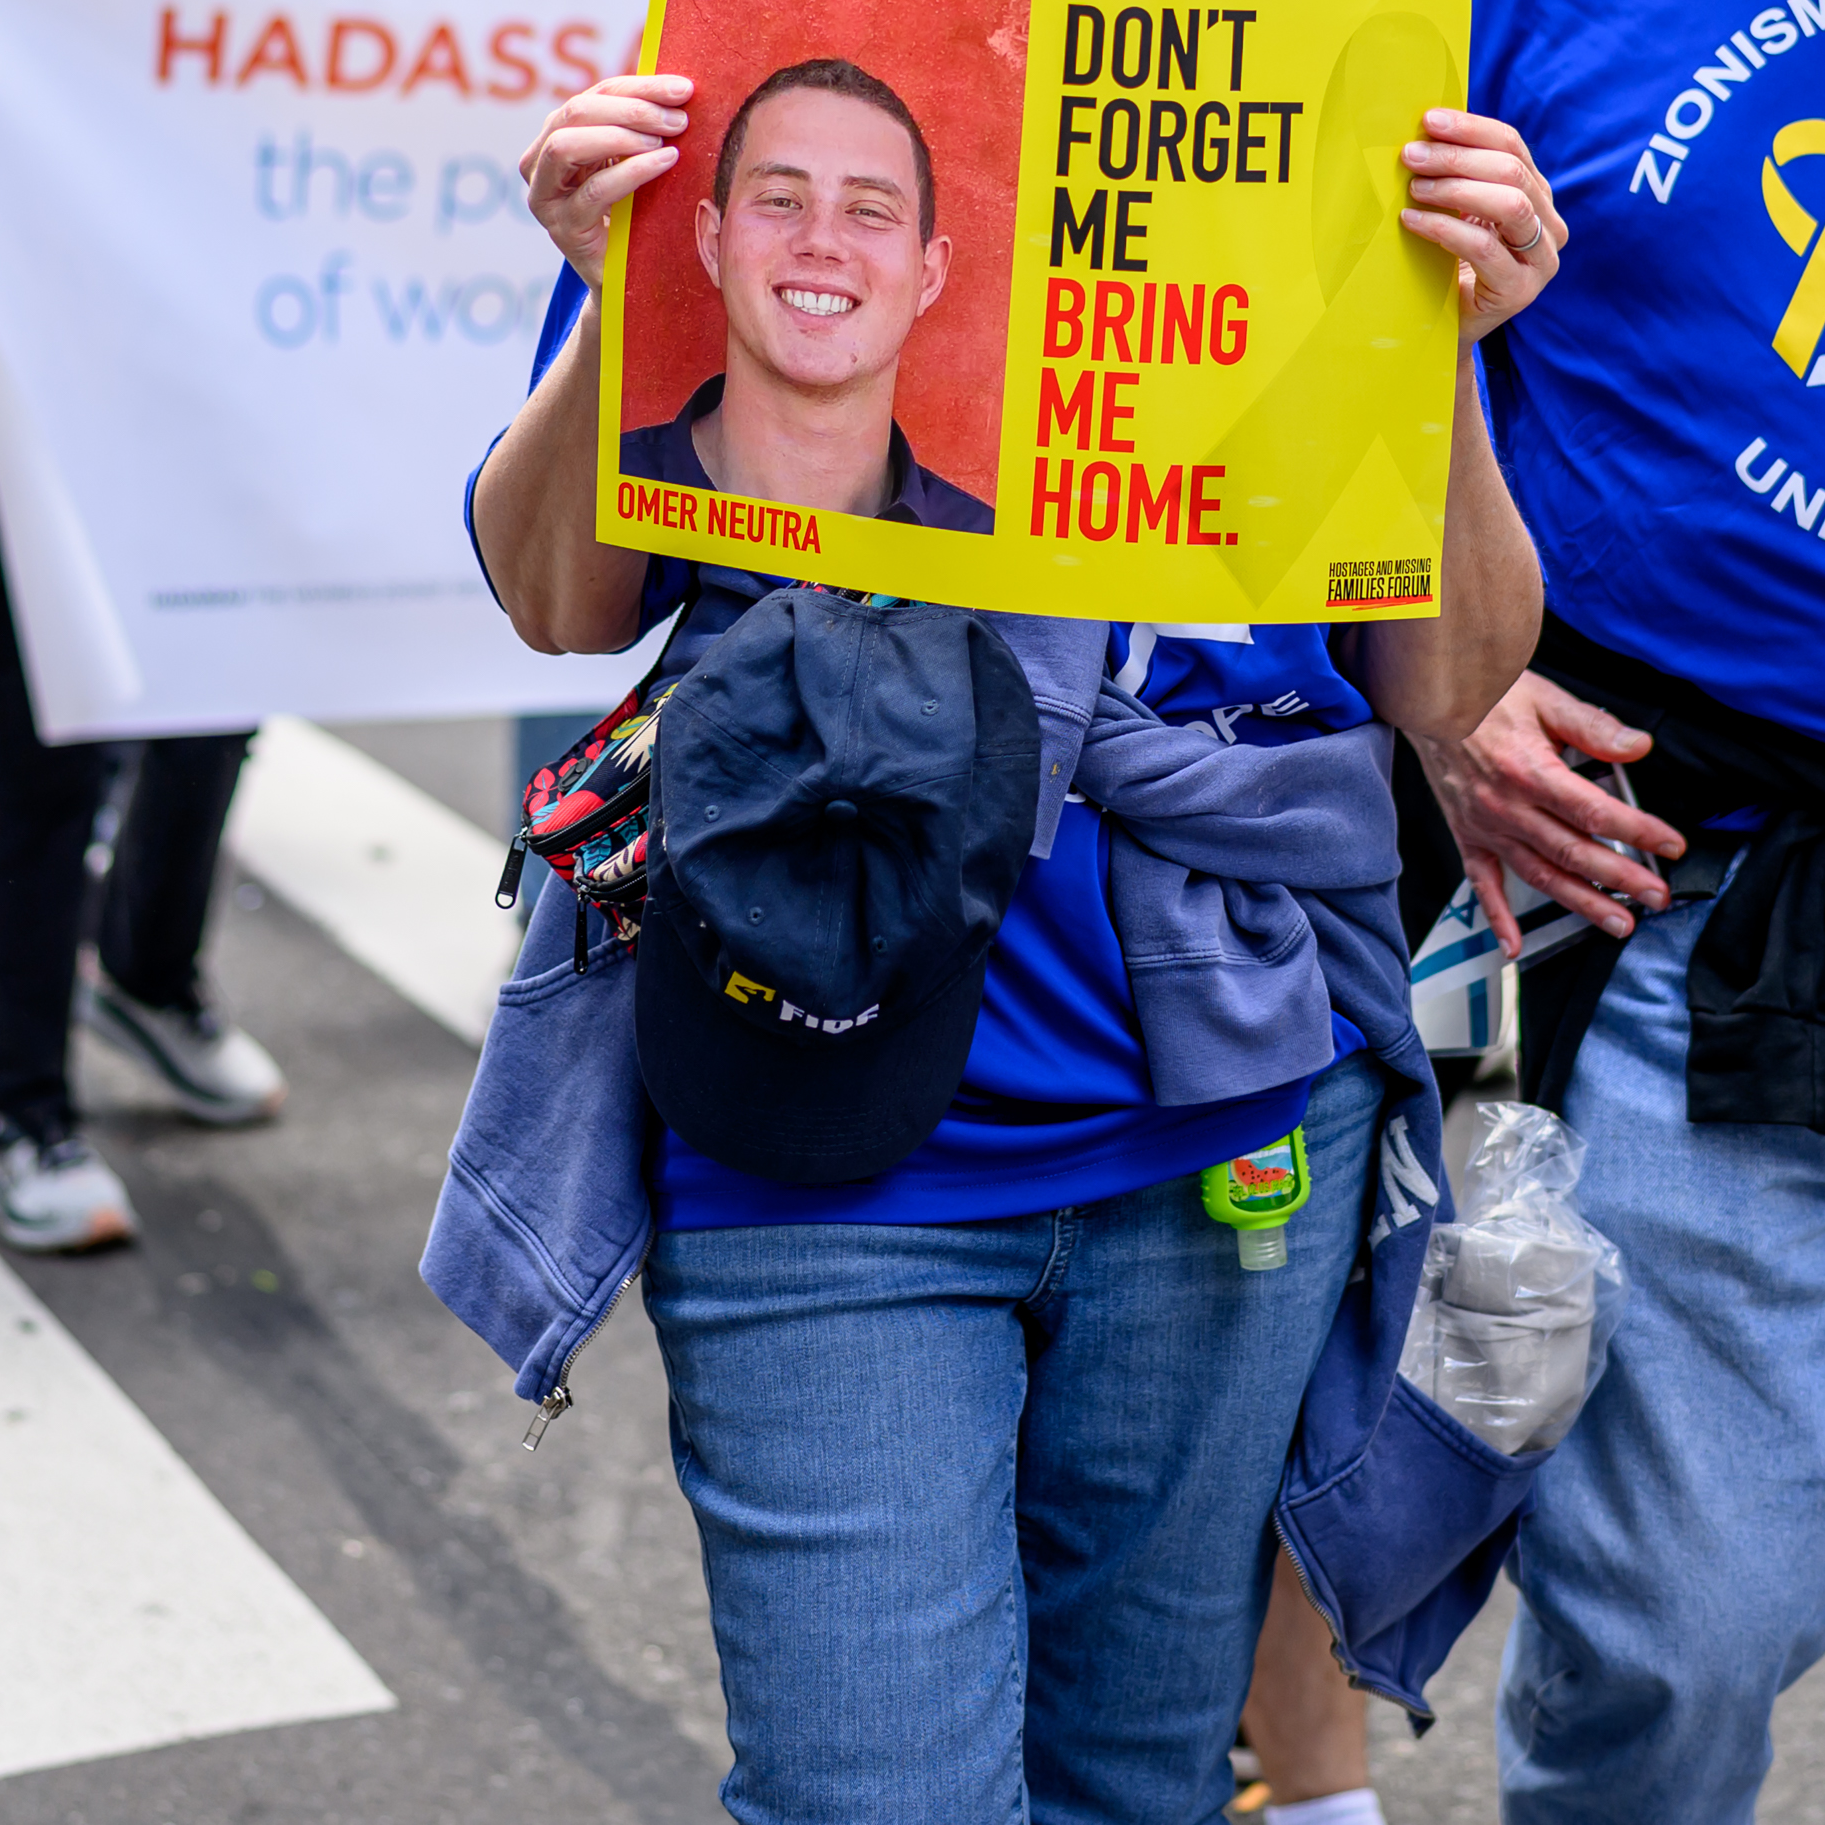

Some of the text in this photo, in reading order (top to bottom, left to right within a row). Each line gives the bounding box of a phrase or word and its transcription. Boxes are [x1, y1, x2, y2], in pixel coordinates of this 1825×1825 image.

[155, 3, 644, 104] HADASS
[1063, 4, 1257, 91] DON'T
[255, 128, 416, 223] the
[1056, 95, 1303, 183] FORGET
[1049, 186, 1152, 272] ME
[254, 249, 354, 349] of
[1041, 277, 1249, 366] BRING
[1036, 366, 1140, 454] ME
[617, 481, 821, 555] OMER NEUTRA
[1029, 456, 1239, 546] HOME.
[1328, 574, 1431, 601] FAMILIES FORUM
[1329, 558, 1431, 578] HOSTAGES AND MISSING
